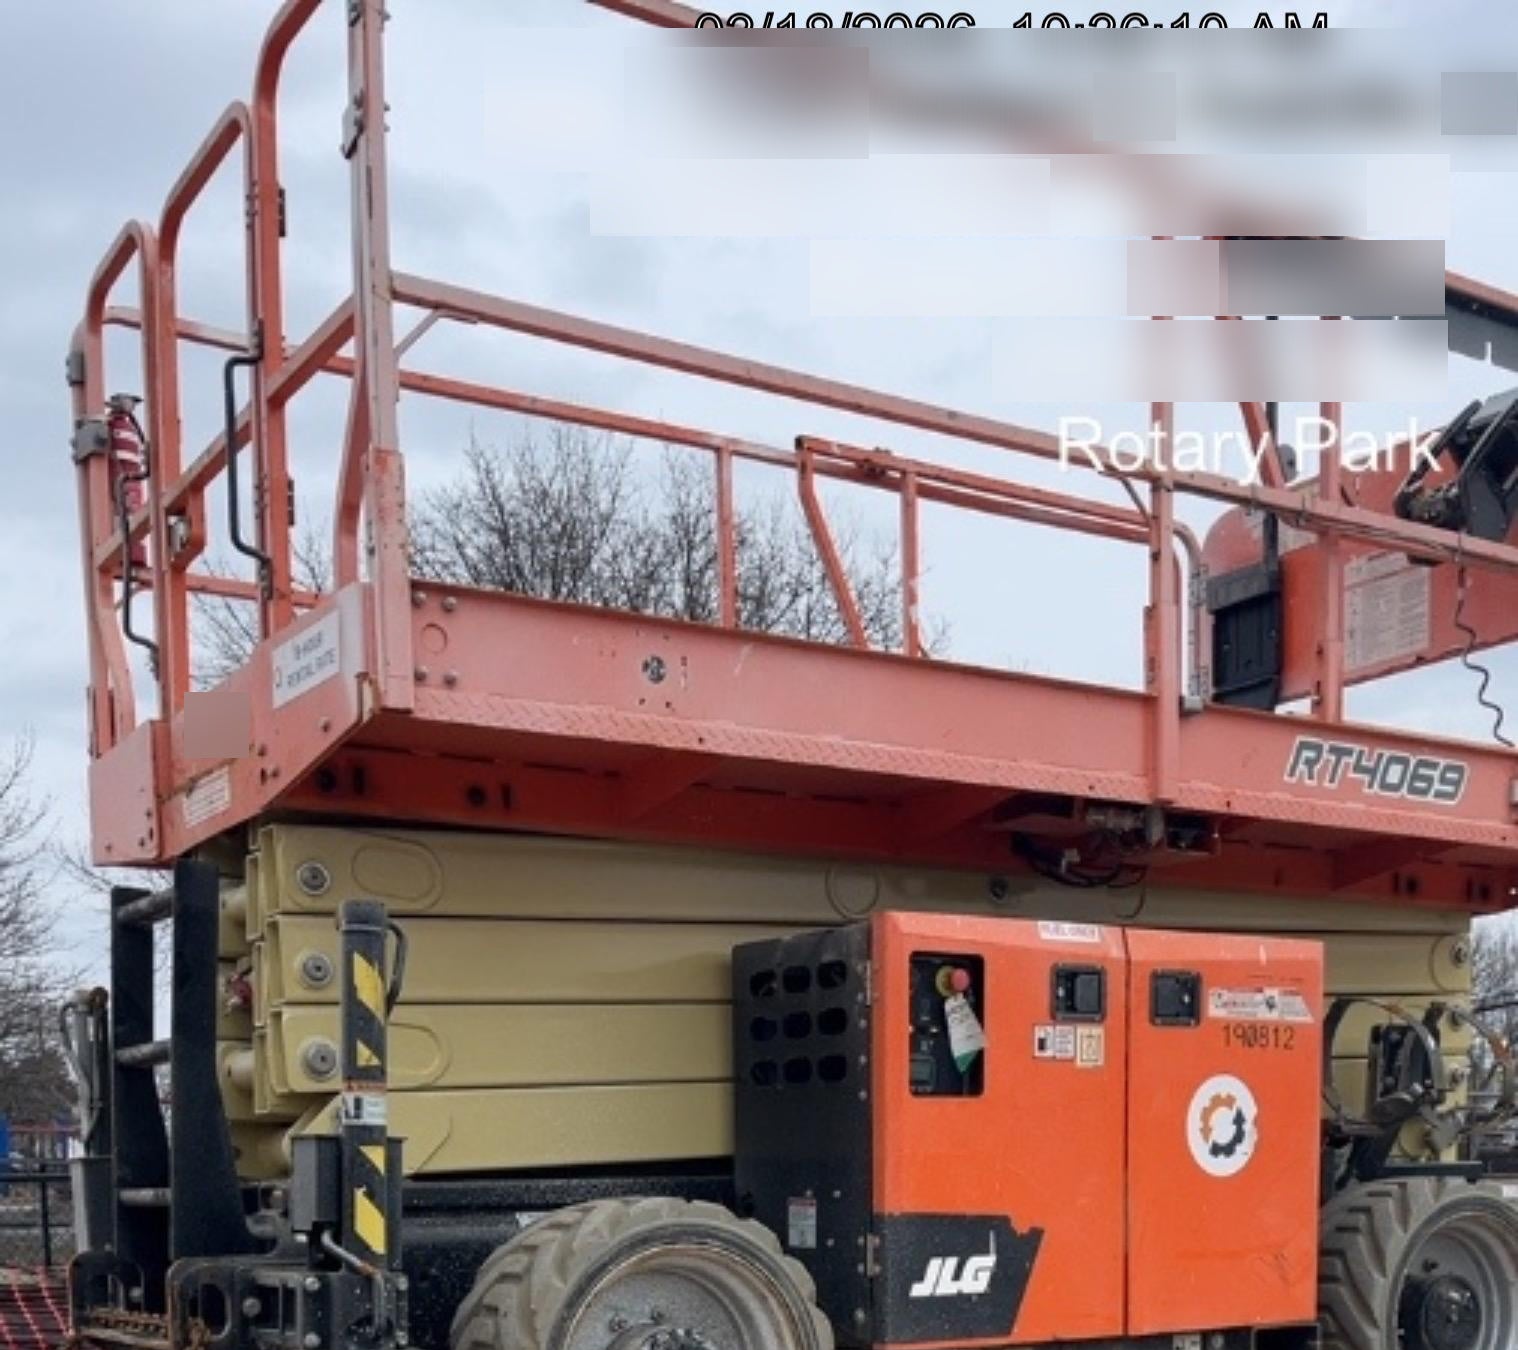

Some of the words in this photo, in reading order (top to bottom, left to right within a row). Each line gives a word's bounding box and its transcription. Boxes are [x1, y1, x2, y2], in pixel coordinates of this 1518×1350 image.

[1285, 737, 1467, 804] RT4069
[1222, 1023, 1295, 1051] 190812
[909, 1253, 997, 1297] JLG
